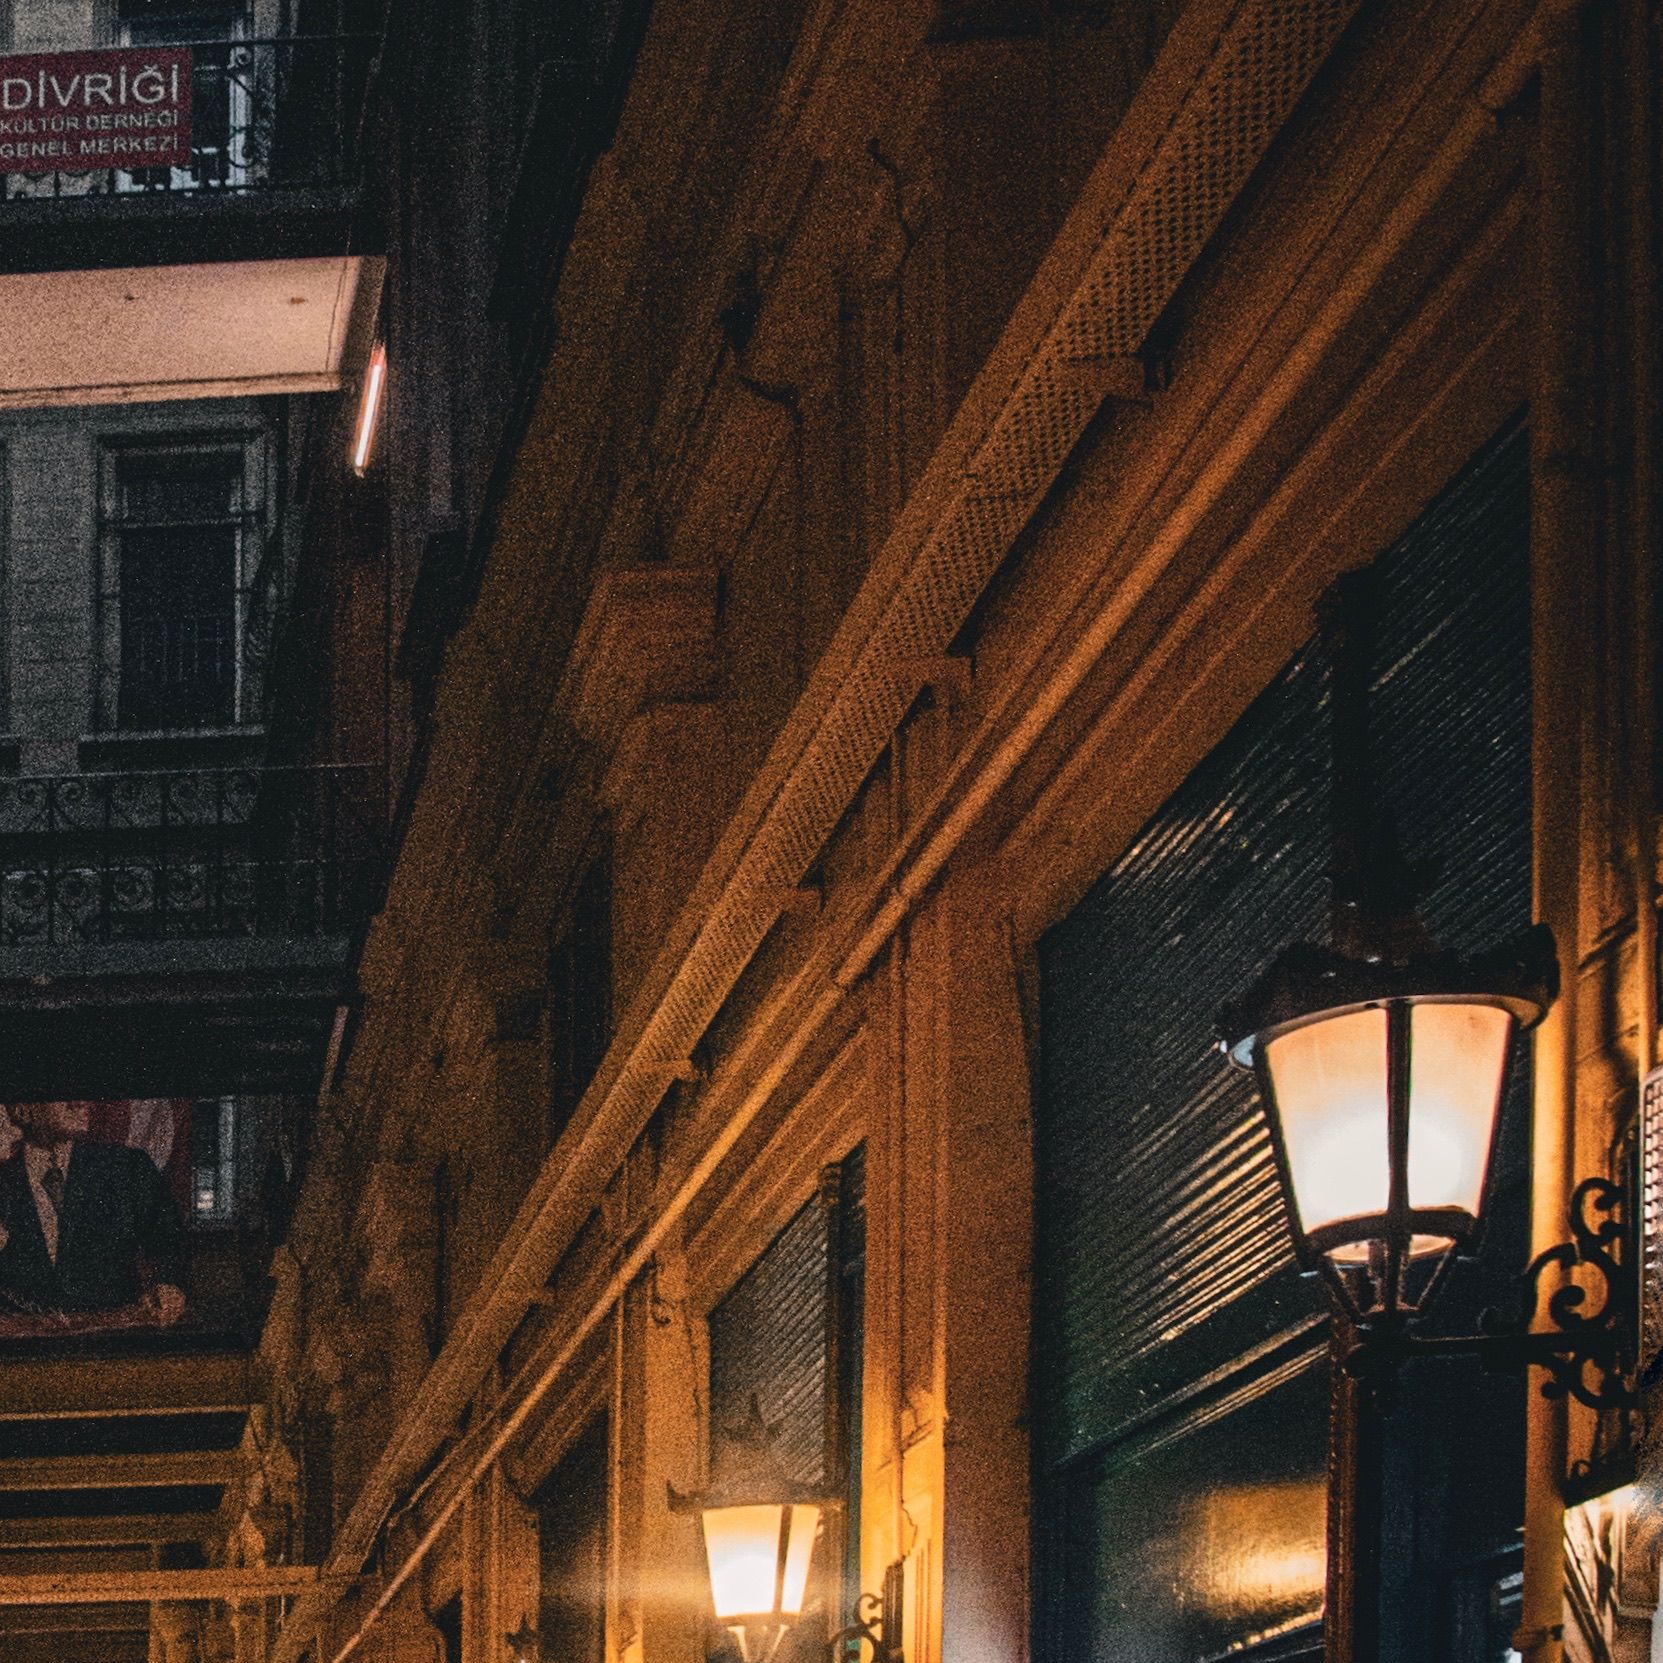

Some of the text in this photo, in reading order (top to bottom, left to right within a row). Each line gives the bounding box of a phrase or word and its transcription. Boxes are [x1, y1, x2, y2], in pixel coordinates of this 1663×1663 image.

[3, 64, 178, 110] DİVRİĞİ
[86, 109, 178, 132] DERNEĞİ
[0, 132, 178, 158] GENEL MERKEZİ
